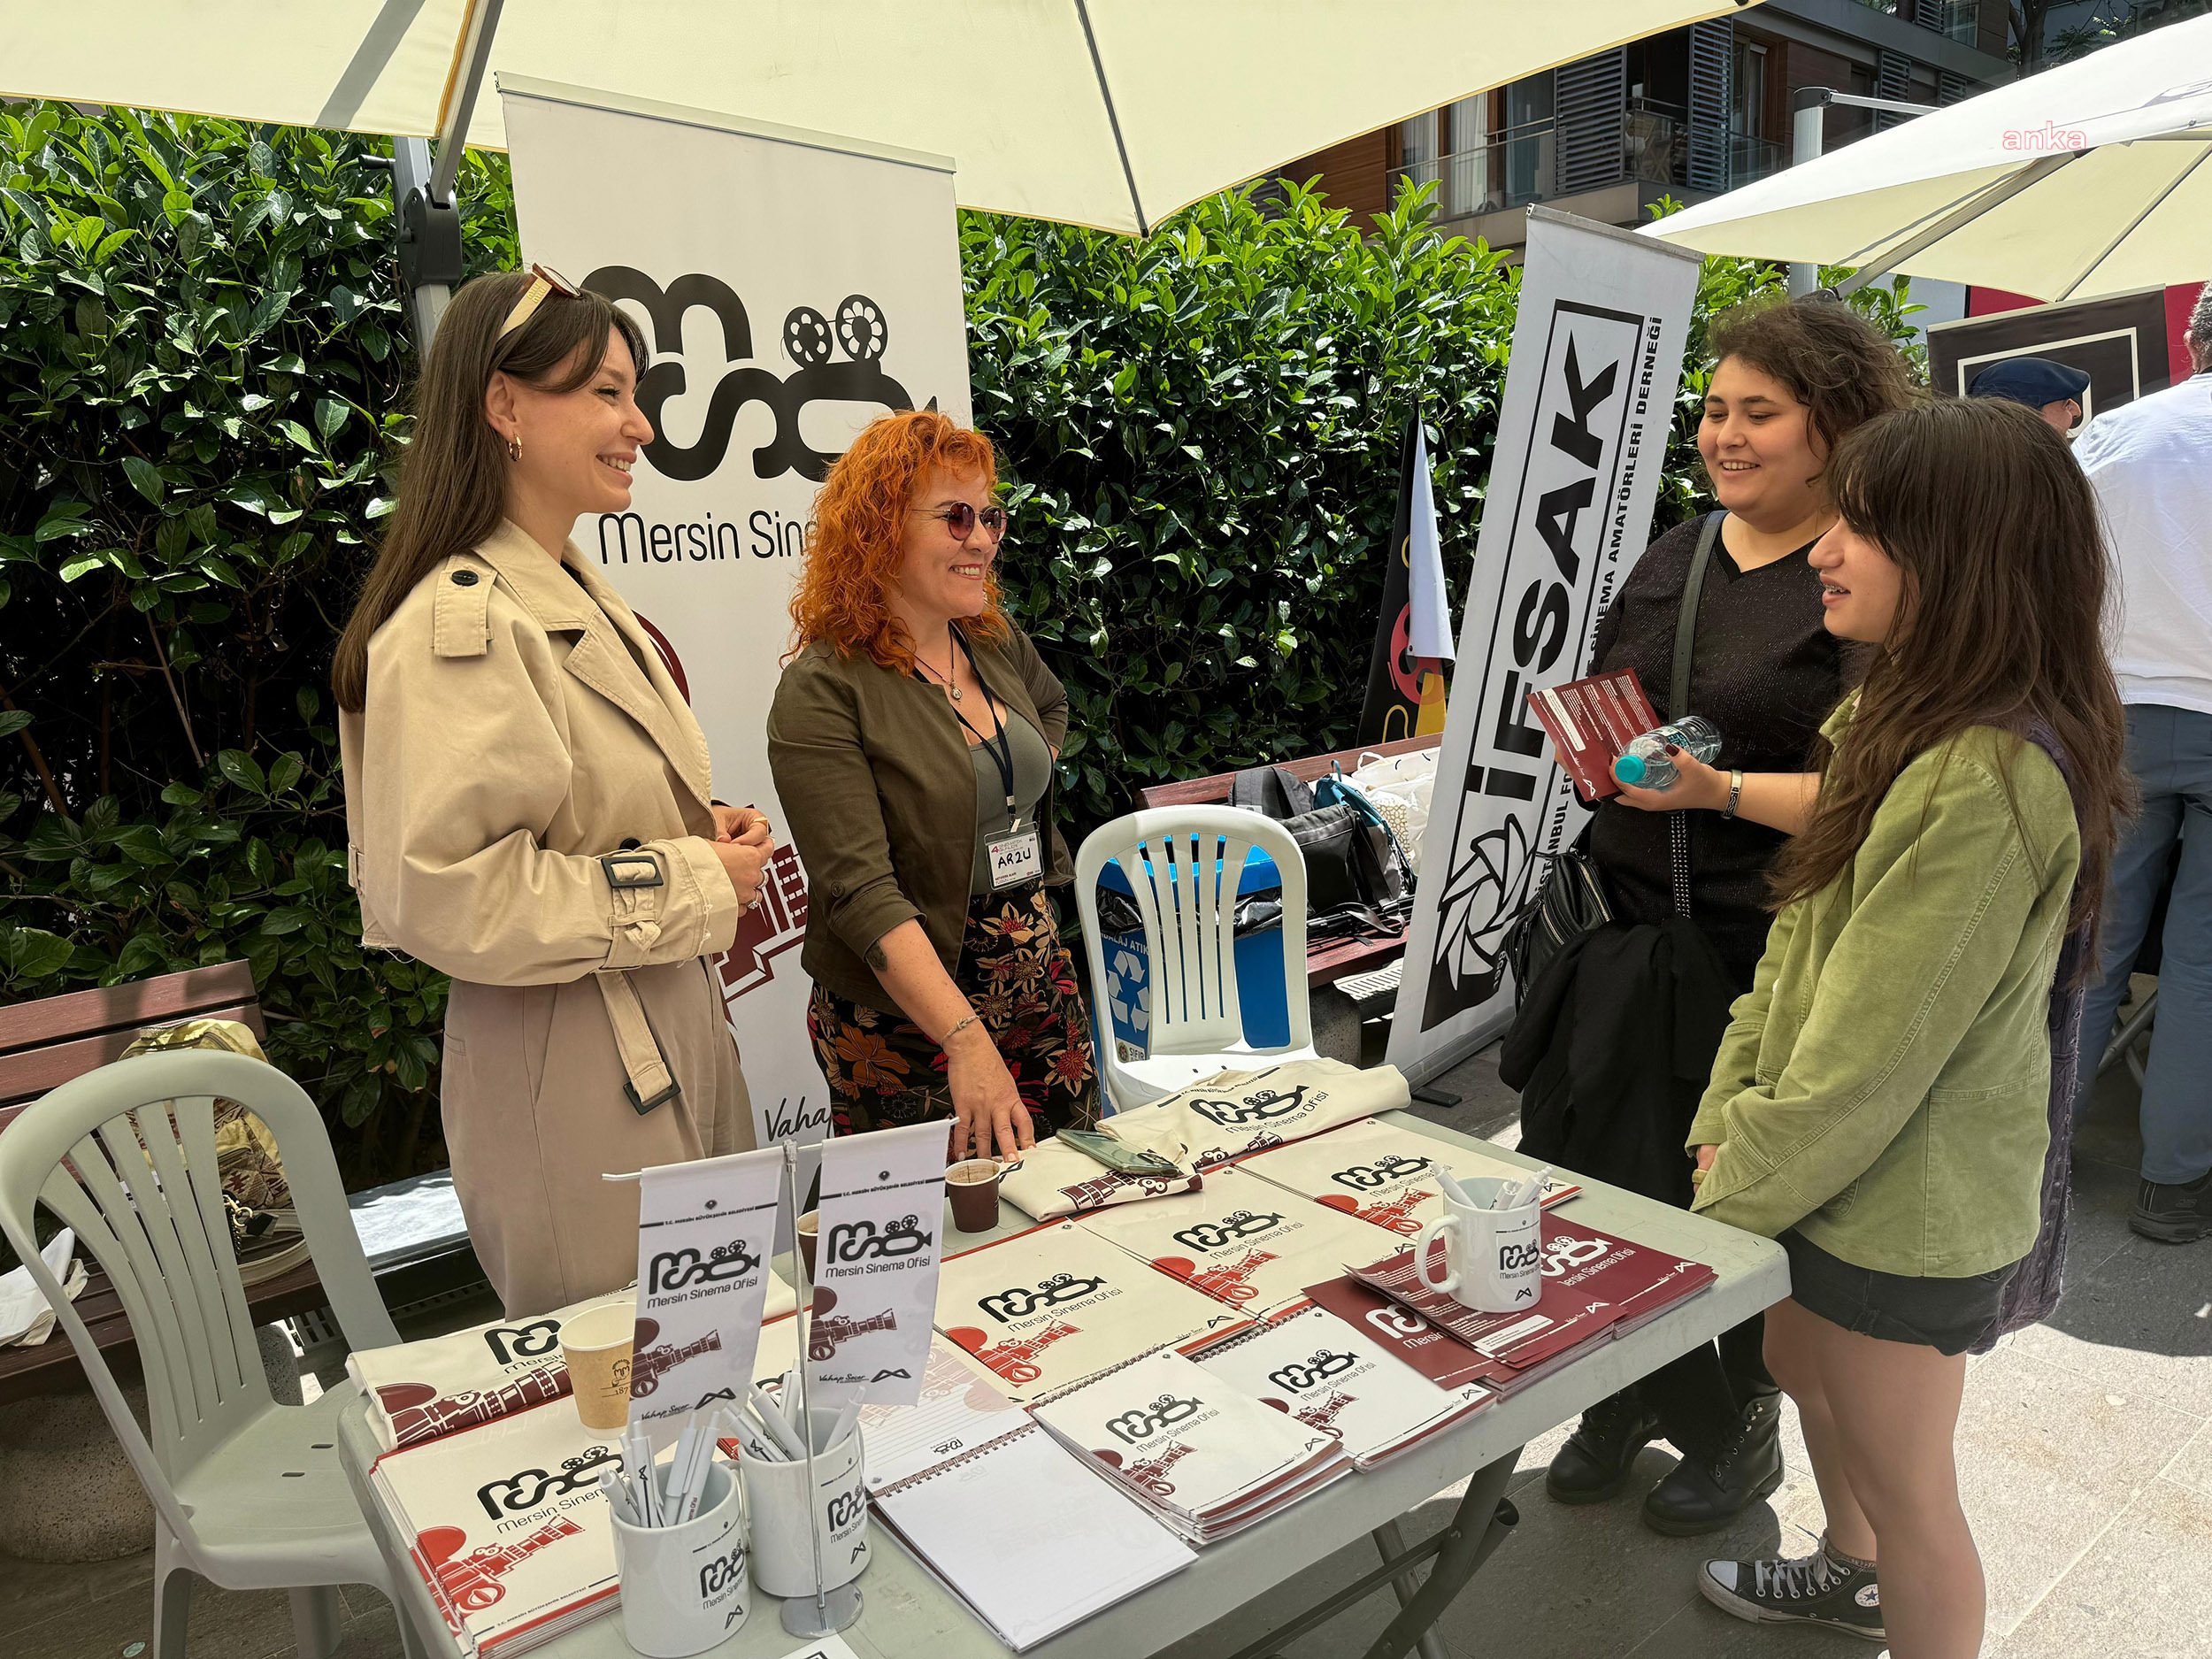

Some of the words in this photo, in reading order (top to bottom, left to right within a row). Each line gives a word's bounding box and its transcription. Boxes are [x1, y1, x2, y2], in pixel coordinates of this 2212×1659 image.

[1609, 421, 1644, 563] AMATÖRLERİ
[1635, 316, 1663, 415] DERNEĞİ
[599, 511, 740, 565] Mersin
[749, 510, 815, 559] Sin
[1464, 329, 1618, 802] İFSAK
[1264, 1111, 1307, 1128] Sinema
[1306, 1090, 1329, 1112] Ofisi
[1210, 1242, 1248, 1260] Mersin
[1245, 1230, 1283, 1247] Sinema
[1279, 1221, 1305, 1236] Ofisi
[826, 1266, 864, 1278] Mersin
[865, 1262, 905, 1274] Sinema
[907, 1256, 931, 1269] Ofisi
[1581, 1257, 1618, 1276] Sinema
[1613, 1248, 1636, 1261] Ofisi
[647, 1294, 687, 1309] Mersin
[689, 1285, 731, 1300] Sinema
[733, 1277, 758, 1291] Ofisi
[1008, 1312, 1054, 1333] Mersin
[1053, 1298, 1096, 1317] Sinema
[1094, 1286, 1124, 1301] Ofisi
[1403, 1331, 1449, 1349] Mersin
[1301, 1385, 1332, 1402] Mersin
[1328, 1371, 1359, 1387] Sinema
[1356, 1362, 1377, 1374] Ofisi
[1136, 1433, 1171, 1453] Mersin
[1167, 1419, 1201, 1437] Sinema
[1197, 1409, 1220, 1422] Ofisi
[496, 1506, 558, 1534] Mersin
[830, 1527, 851, 1543] Mersin
[703, 1592, 726, 1610] Mersin
